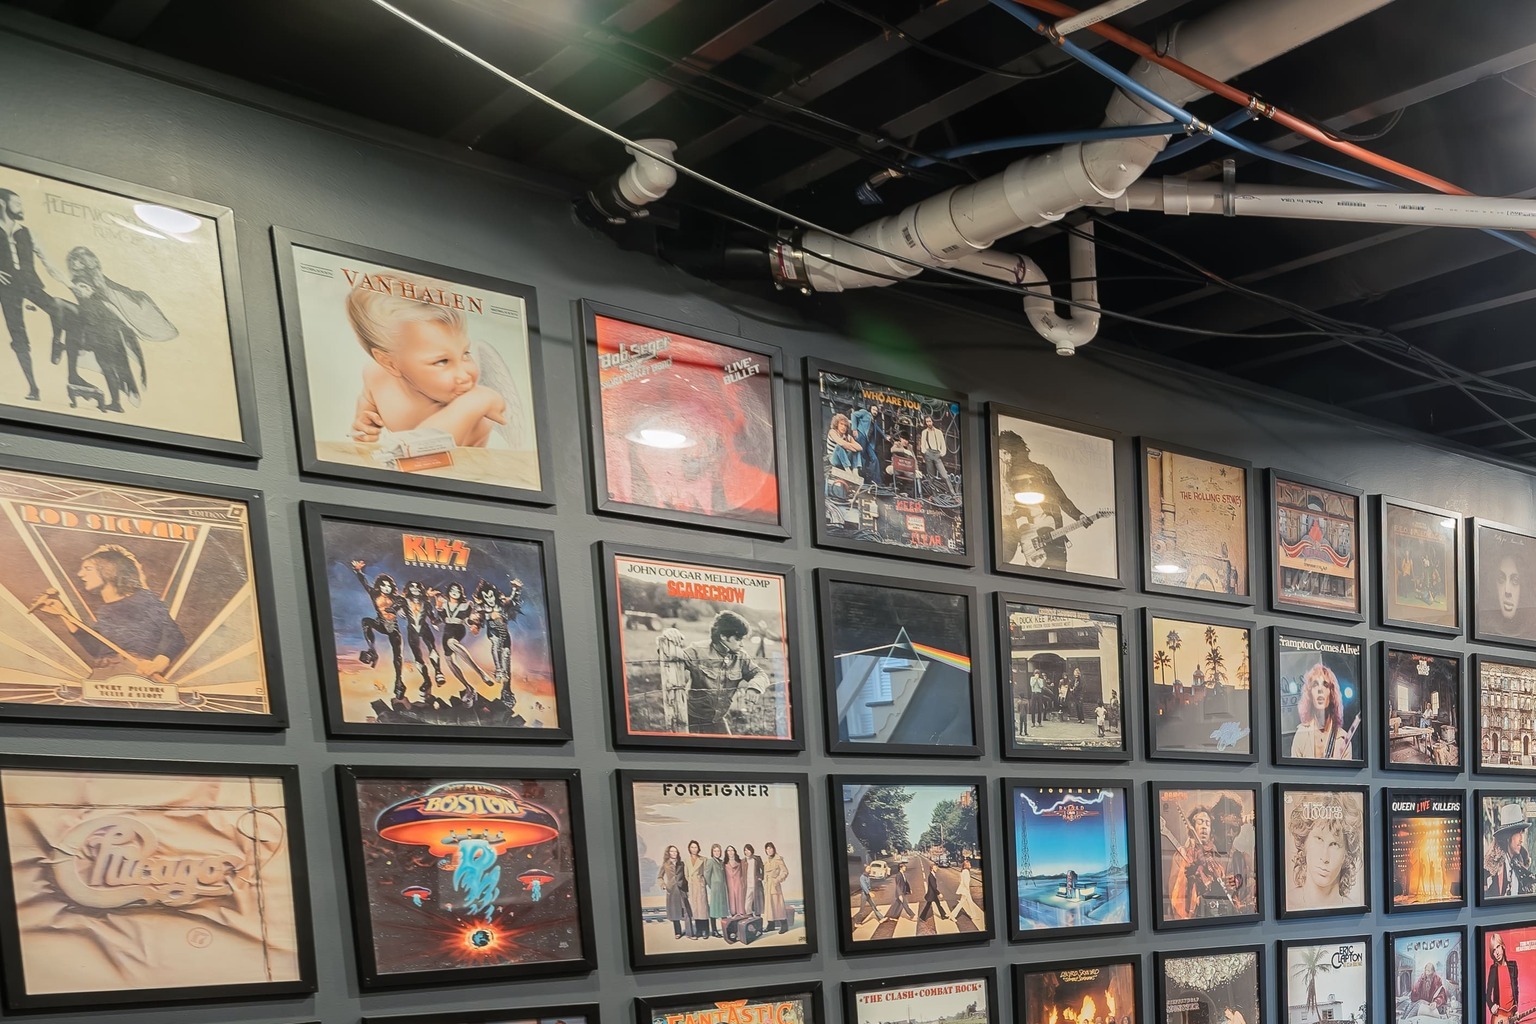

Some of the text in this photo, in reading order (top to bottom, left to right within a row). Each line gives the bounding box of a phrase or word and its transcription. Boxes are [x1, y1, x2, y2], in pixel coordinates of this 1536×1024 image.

[341, 268, 483, 315] VAN HALEN
[723, 364, 760, 385] BULLET
[862, 389, 921, 411] WHO ARE YOU
[1180, 491, 1192, 500] THE
[1193, 491, 1221, 503] ROLLING
[20, 504, 198, 541] ROD STEWART
[402, 533, 471, 567] KISS
[628, 564, 770, 588] JOHN COUGAR MELLENCAMP
[667, 580, 745, 604] SCARECROW
[1314, 640, 1340, 654] Comes
[1339, 643, 1360, 656] Alive!
[663, 783, 769, 797] FOREIGNER
[424, 794, 521, 815] BOSTON
[1392, 800, 1461, 813] QUEEN LIVE KILLERS
[54, 815, 246, 909] Chicago
[1331, 951, 1363, 969] CLAPTON
[1339, 945, 1354, 955] ERIC
[863, 983, 979, 1004] THE CLASH COMBAT ROCK
